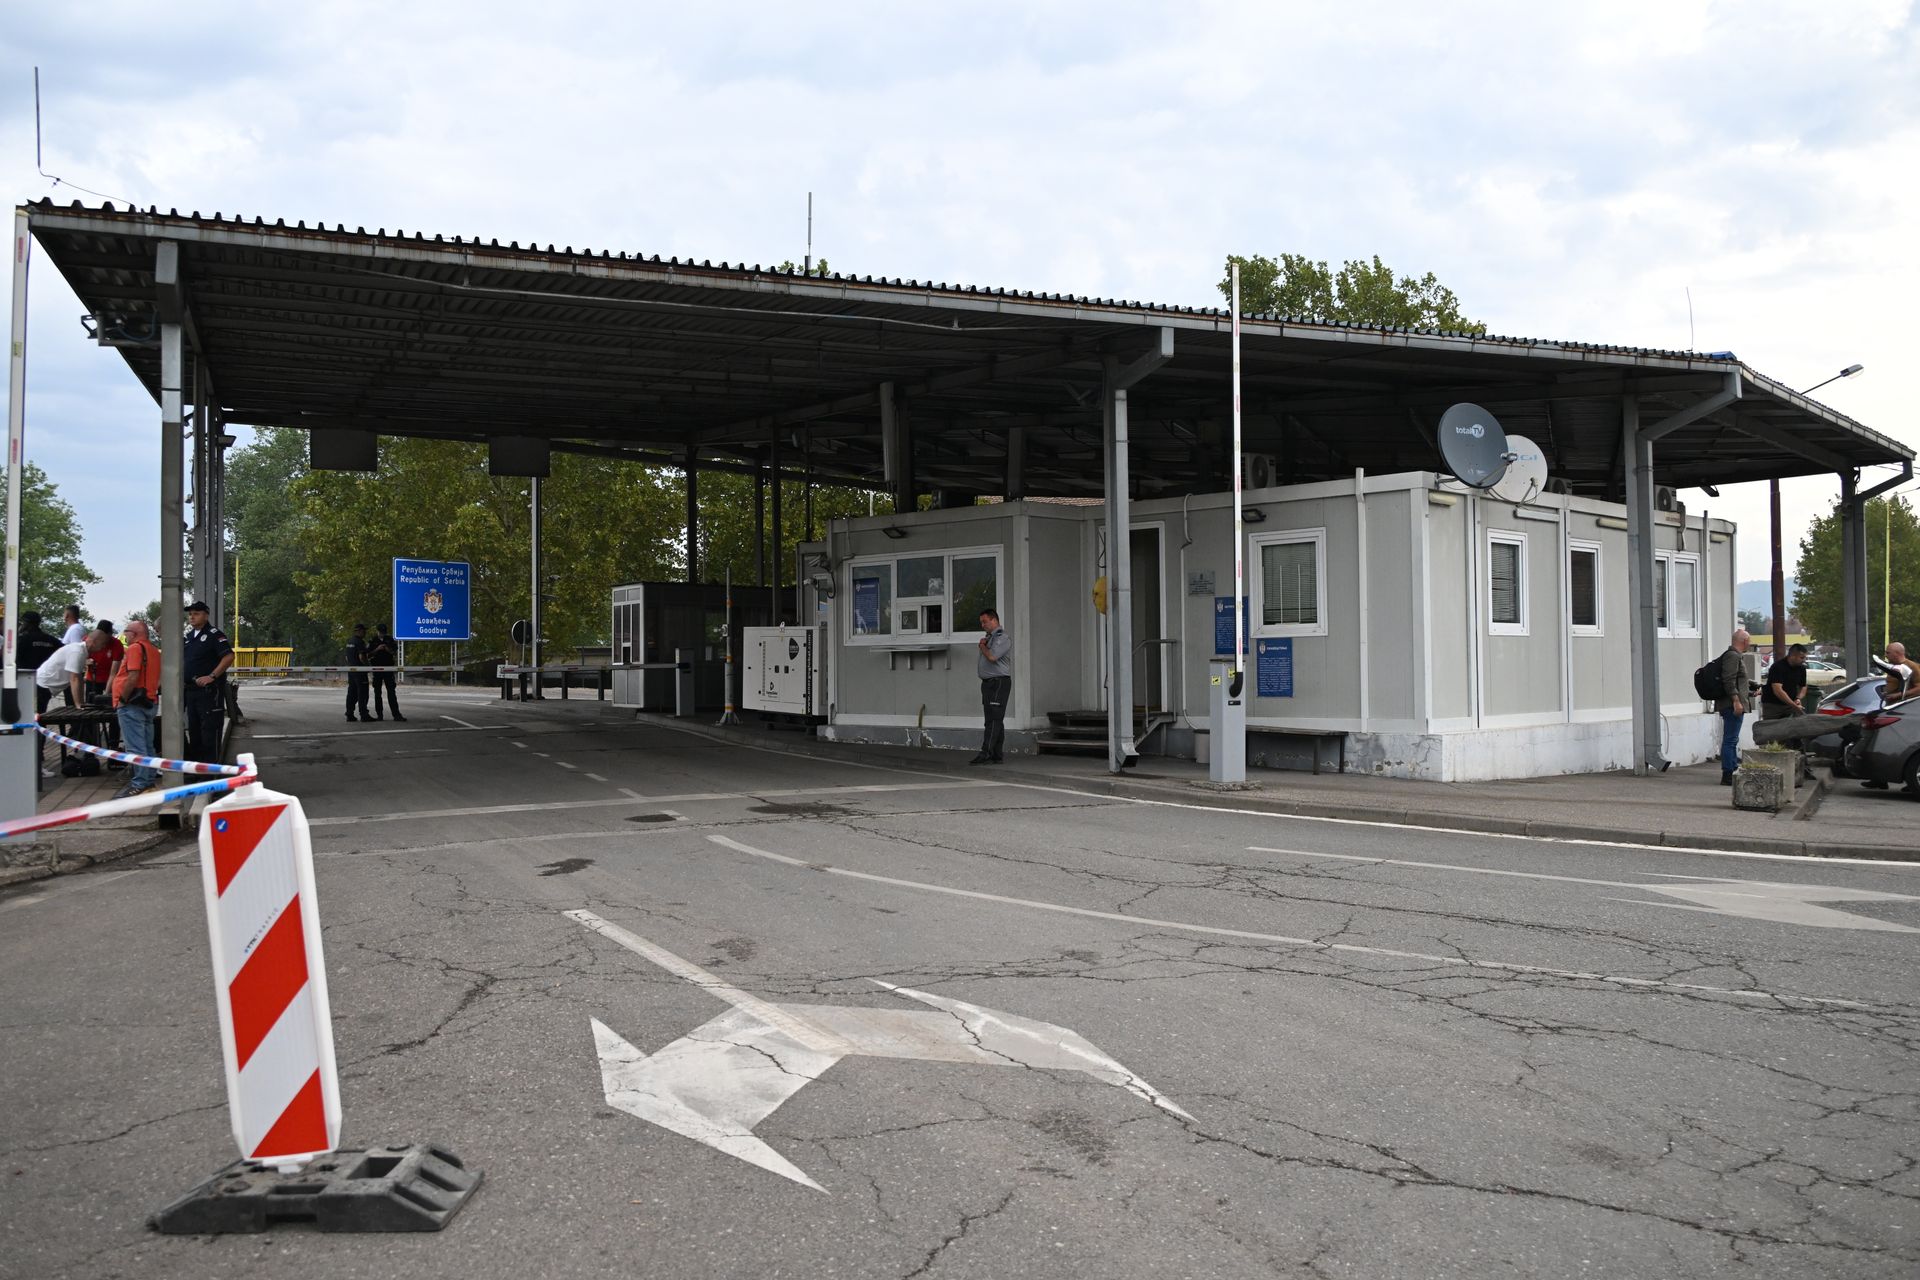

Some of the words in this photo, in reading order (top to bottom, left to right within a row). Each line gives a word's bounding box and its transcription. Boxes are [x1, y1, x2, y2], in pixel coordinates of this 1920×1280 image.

[401, 565, 438, 575] Република
[441, 567, 464, 577] Србија
[400, 575, 429, 584] Republic
[444, 577, 465, 585] Serbia
[416, 617, 451, 625] Довиђења
[419, 626, 448, 635] Goodbye
